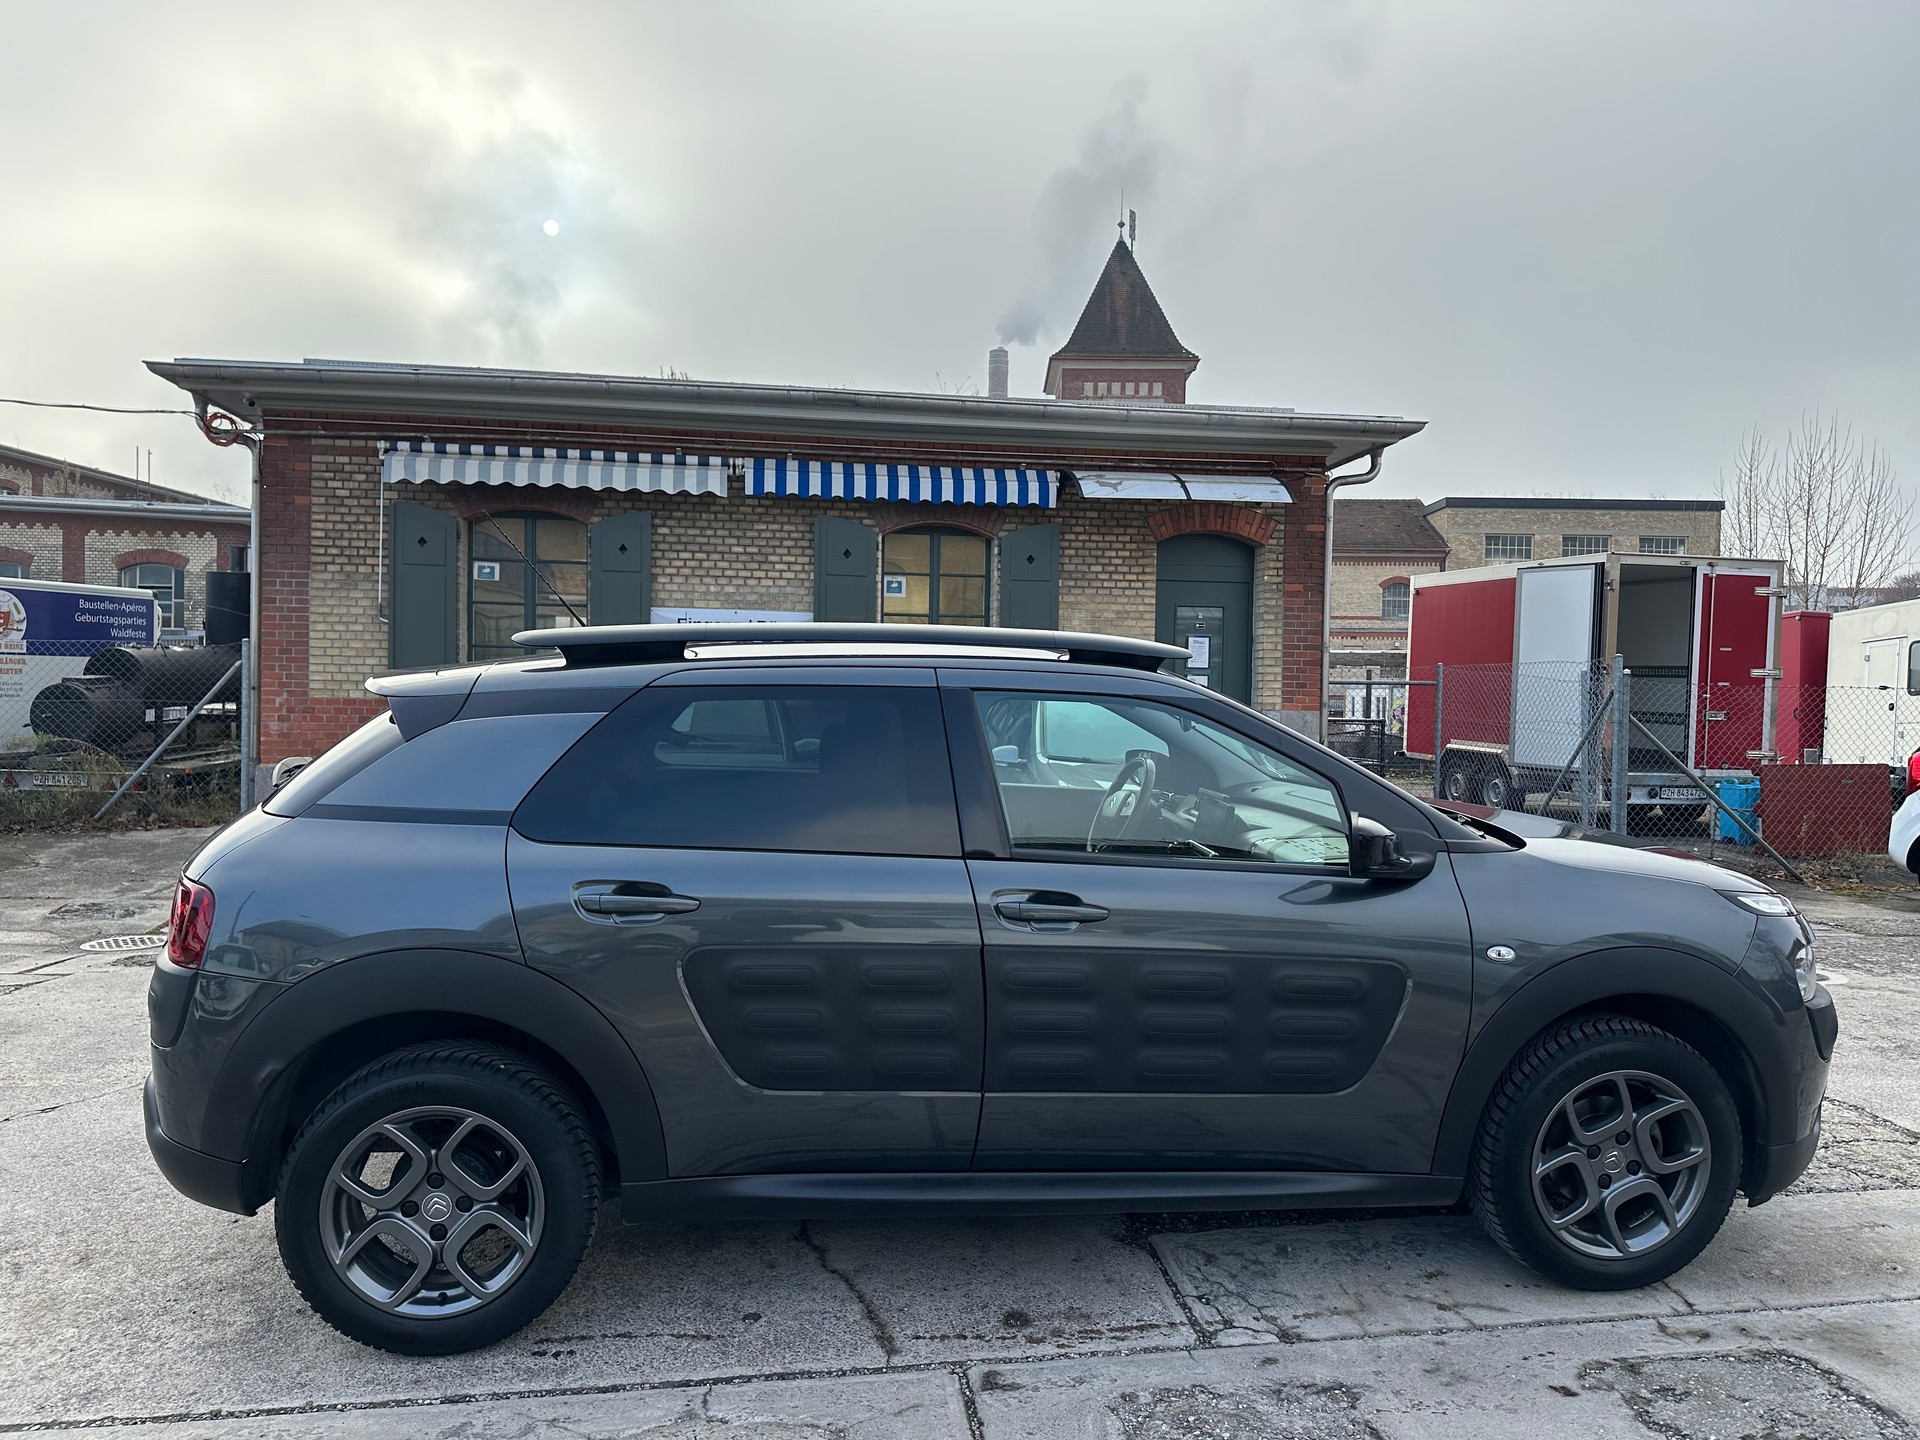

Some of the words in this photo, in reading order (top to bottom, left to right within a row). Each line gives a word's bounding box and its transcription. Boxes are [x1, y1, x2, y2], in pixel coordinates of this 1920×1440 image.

[79, 599, 147, 613] Baustellen-Apéros
[75, 612, 147, 626] Geburtstagsparties
[110, 628, 147, 638] Waldfeste
[415, 1081, 425, 1090] H
